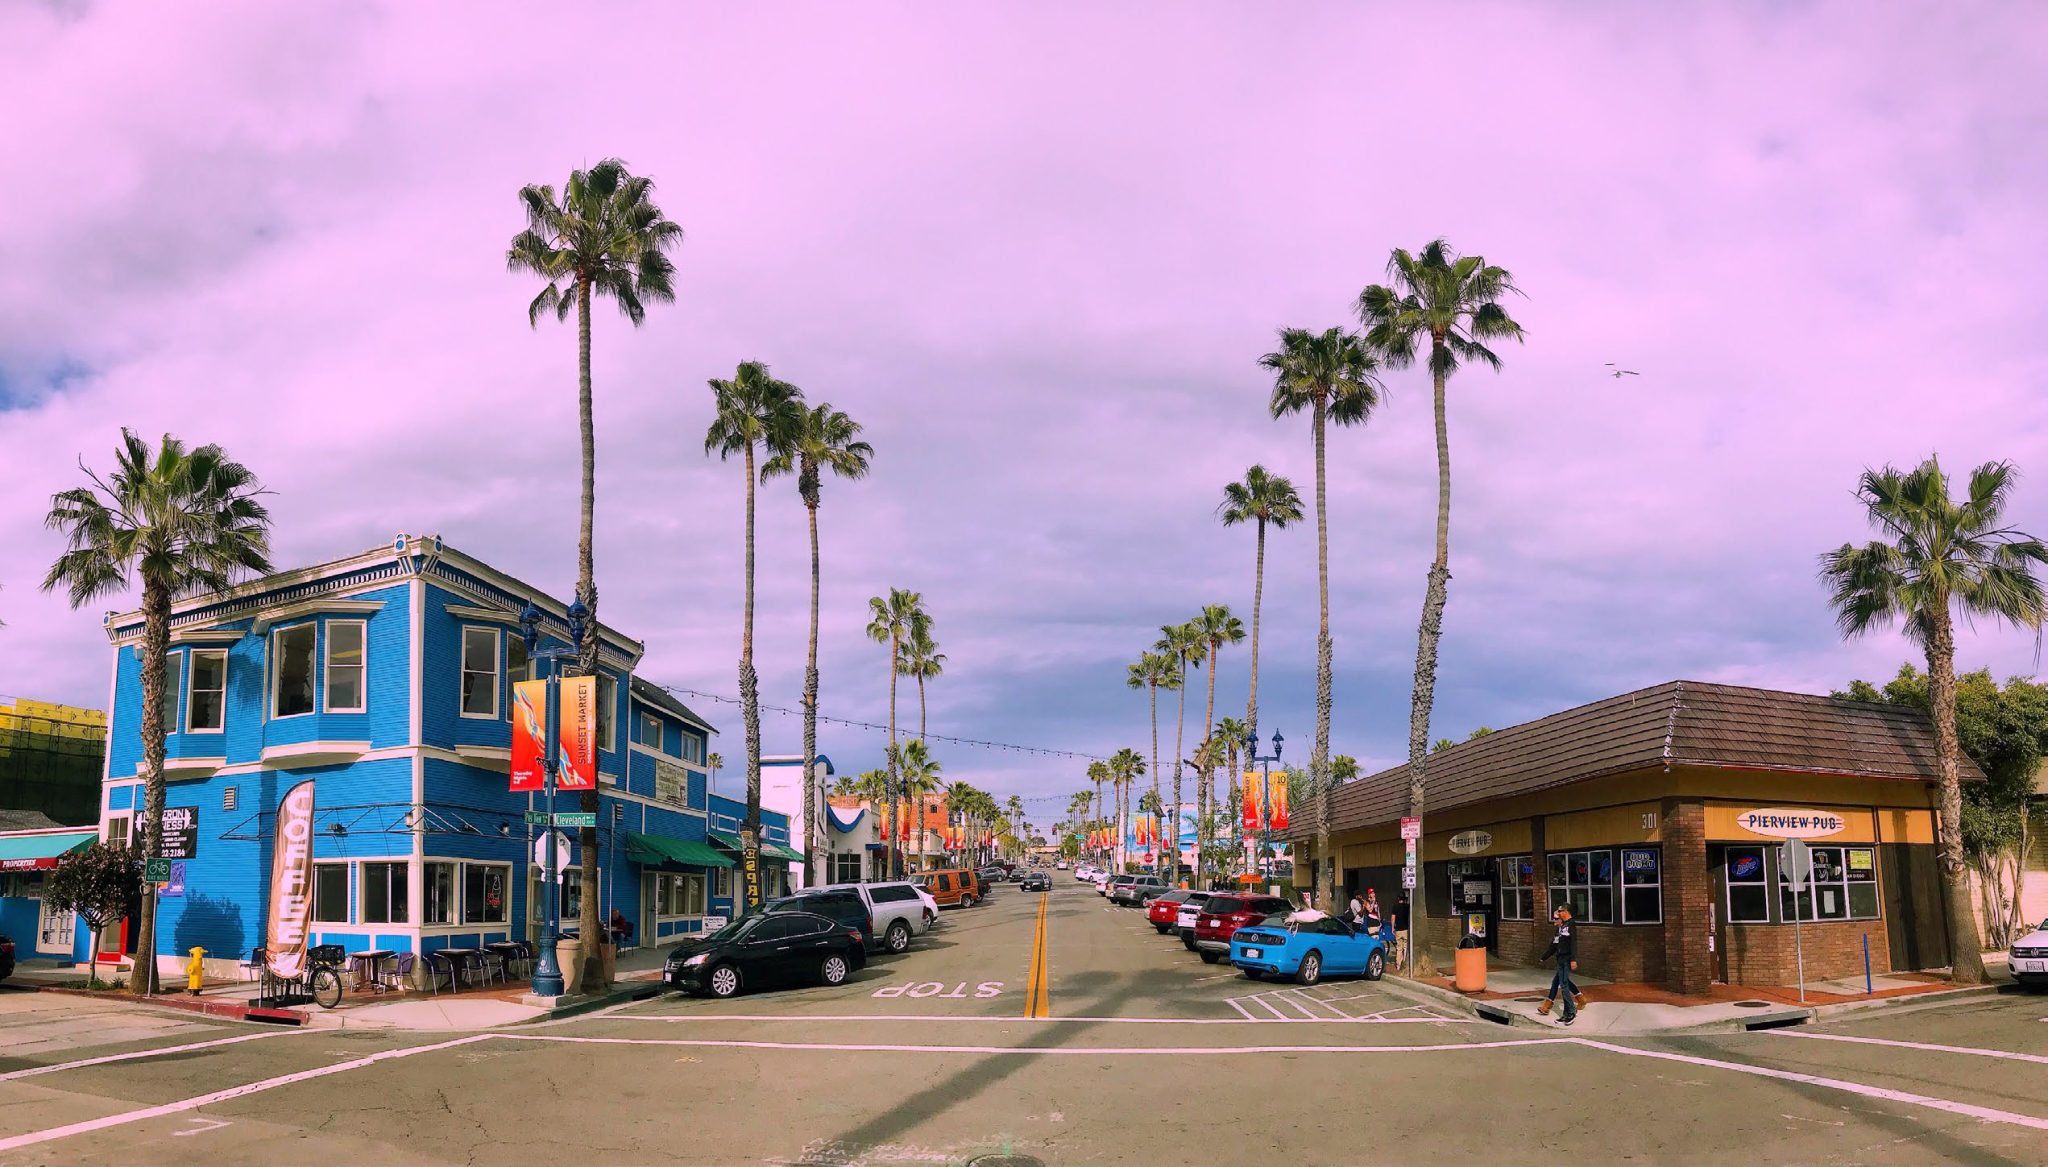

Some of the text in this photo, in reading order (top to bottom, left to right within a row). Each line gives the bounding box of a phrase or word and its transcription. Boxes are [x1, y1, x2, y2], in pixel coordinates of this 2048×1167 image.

[578, 684, 587, 764] SUNSET MARKET
[1277, 775, 1286, 784] 10
[556, 815, 585, 825] Cleveland
[1642, 813, 1657, 829] 301
[1748, 814, 1836, 830] PIERVIEW PUB
[1476, 835, 1488, 848] PUB
[277, 790, 310, 944] COFFEE
[1626, 860, 1654, 868] LIGHT
[871, 980, 1005, 999] STOP
